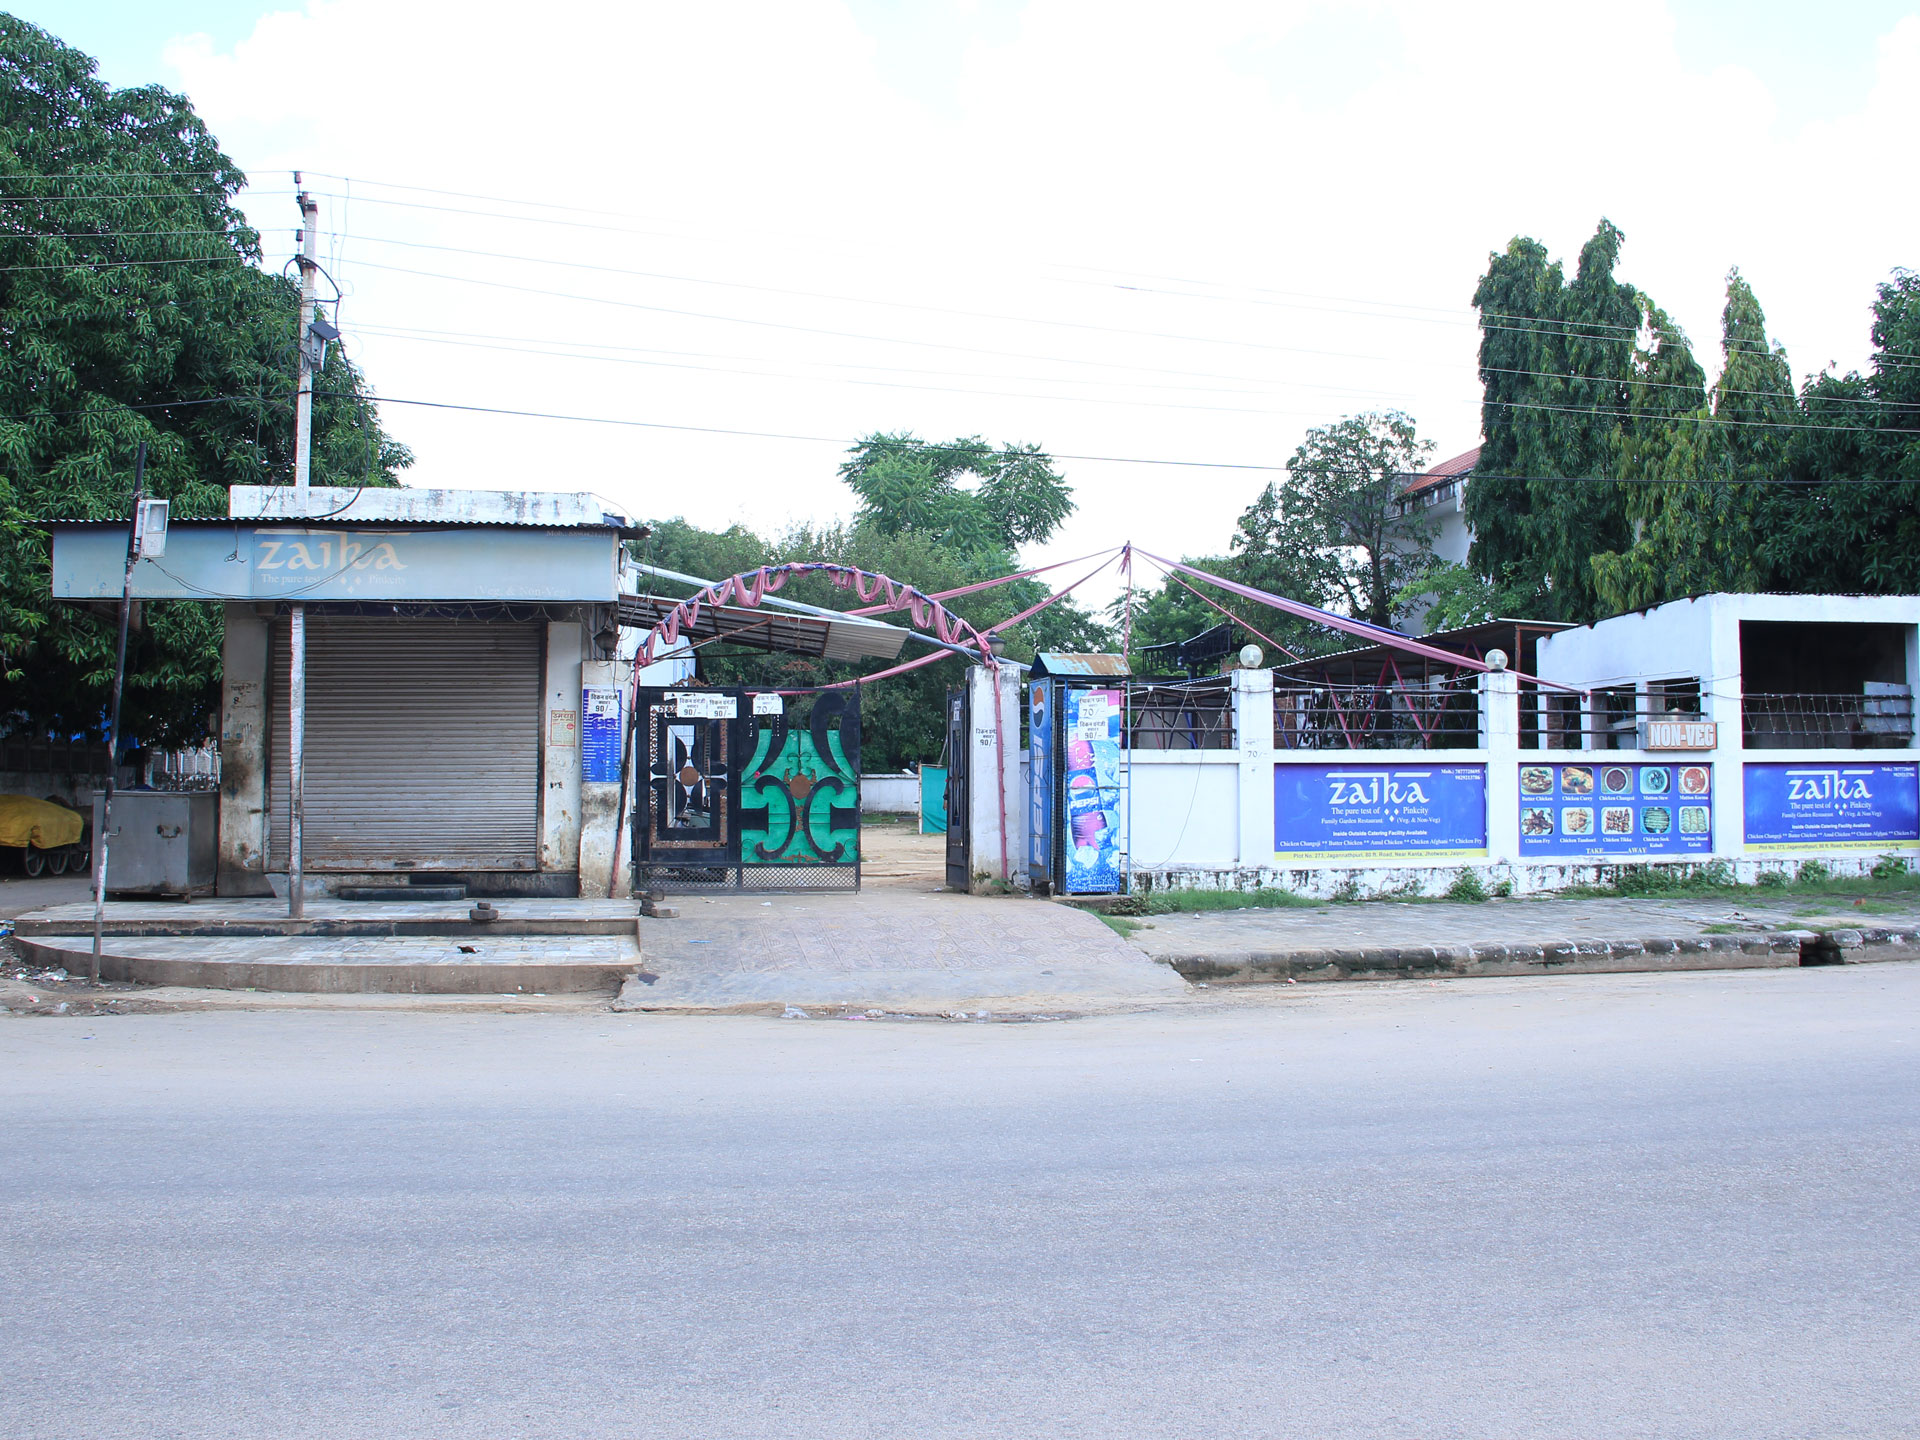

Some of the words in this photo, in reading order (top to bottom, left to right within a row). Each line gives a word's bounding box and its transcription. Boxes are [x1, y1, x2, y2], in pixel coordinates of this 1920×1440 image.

[256, 531, 409, 570] zaika
[261, 574, 279, 583] The
[281, 575, 302, 585] pure
[90, 586, 123, 596] Garde
[596, 705, 613, 713] 90/-
[714, 710, 732, 718] 90/-
[1083, 708, 1105, 716] 70/-
[1085, 732, 1102, 740] 90/-
[1650, 724, 1714, 747] NON-VEG
[1325, 772, 1431, 805] zaika
[1034, 735, 1044, 866] PEPSI
[1070, 797, 1099, 809] PEPSI
[1331, 807, 1344, 815] The
[1403, 806, 1429, 816] Pinkcity
